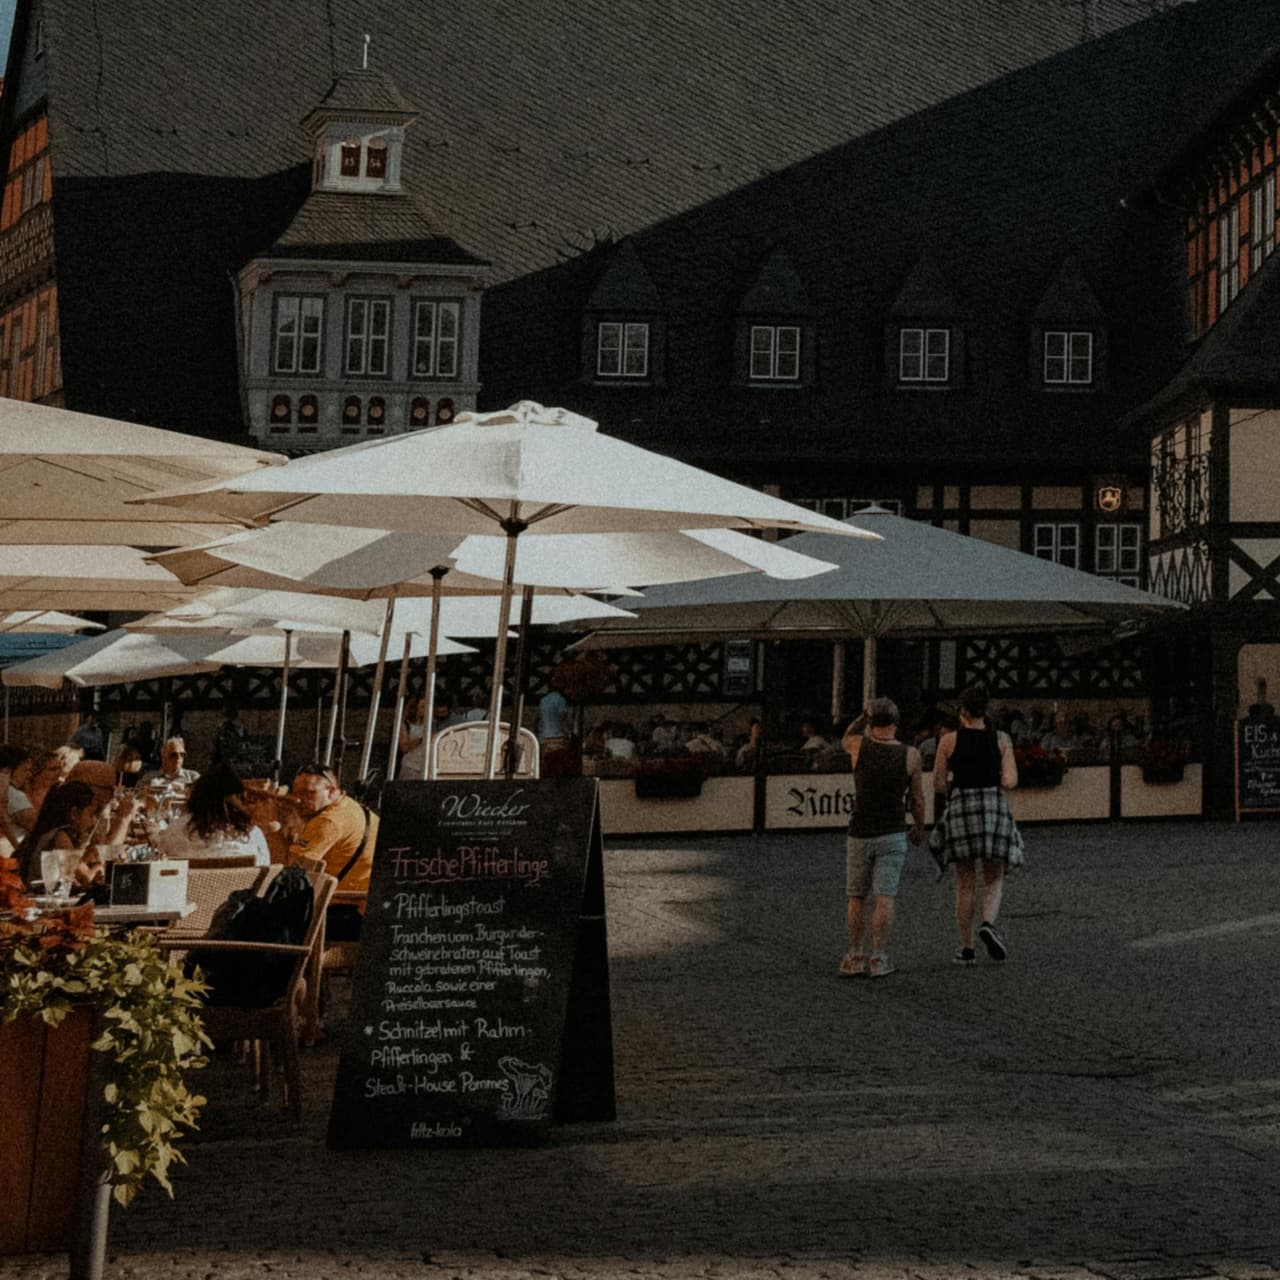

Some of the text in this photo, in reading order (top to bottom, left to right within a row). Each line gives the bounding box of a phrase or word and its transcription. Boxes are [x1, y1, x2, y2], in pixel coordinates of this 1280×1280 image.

[1244, 724, 1268, 744] EIS
[441, 788, 531, 818] Wiecker
[787, 787, 855, 816] Rats
[388, 844, 549, 880] Frische Pfifferlinge
[394, 892, 506, 923] Pfifferlingstoast
[507, 944, 543, 961] Toast
[389, 965, 412, 977] mit
[378, 1019, 442, 1041] Schnitzel
[443, 1020, 470, 1038] mit
[371, 1045, 453, 1075] Pfifferlingen
[459, 1071, 510, 1094] Pommes
